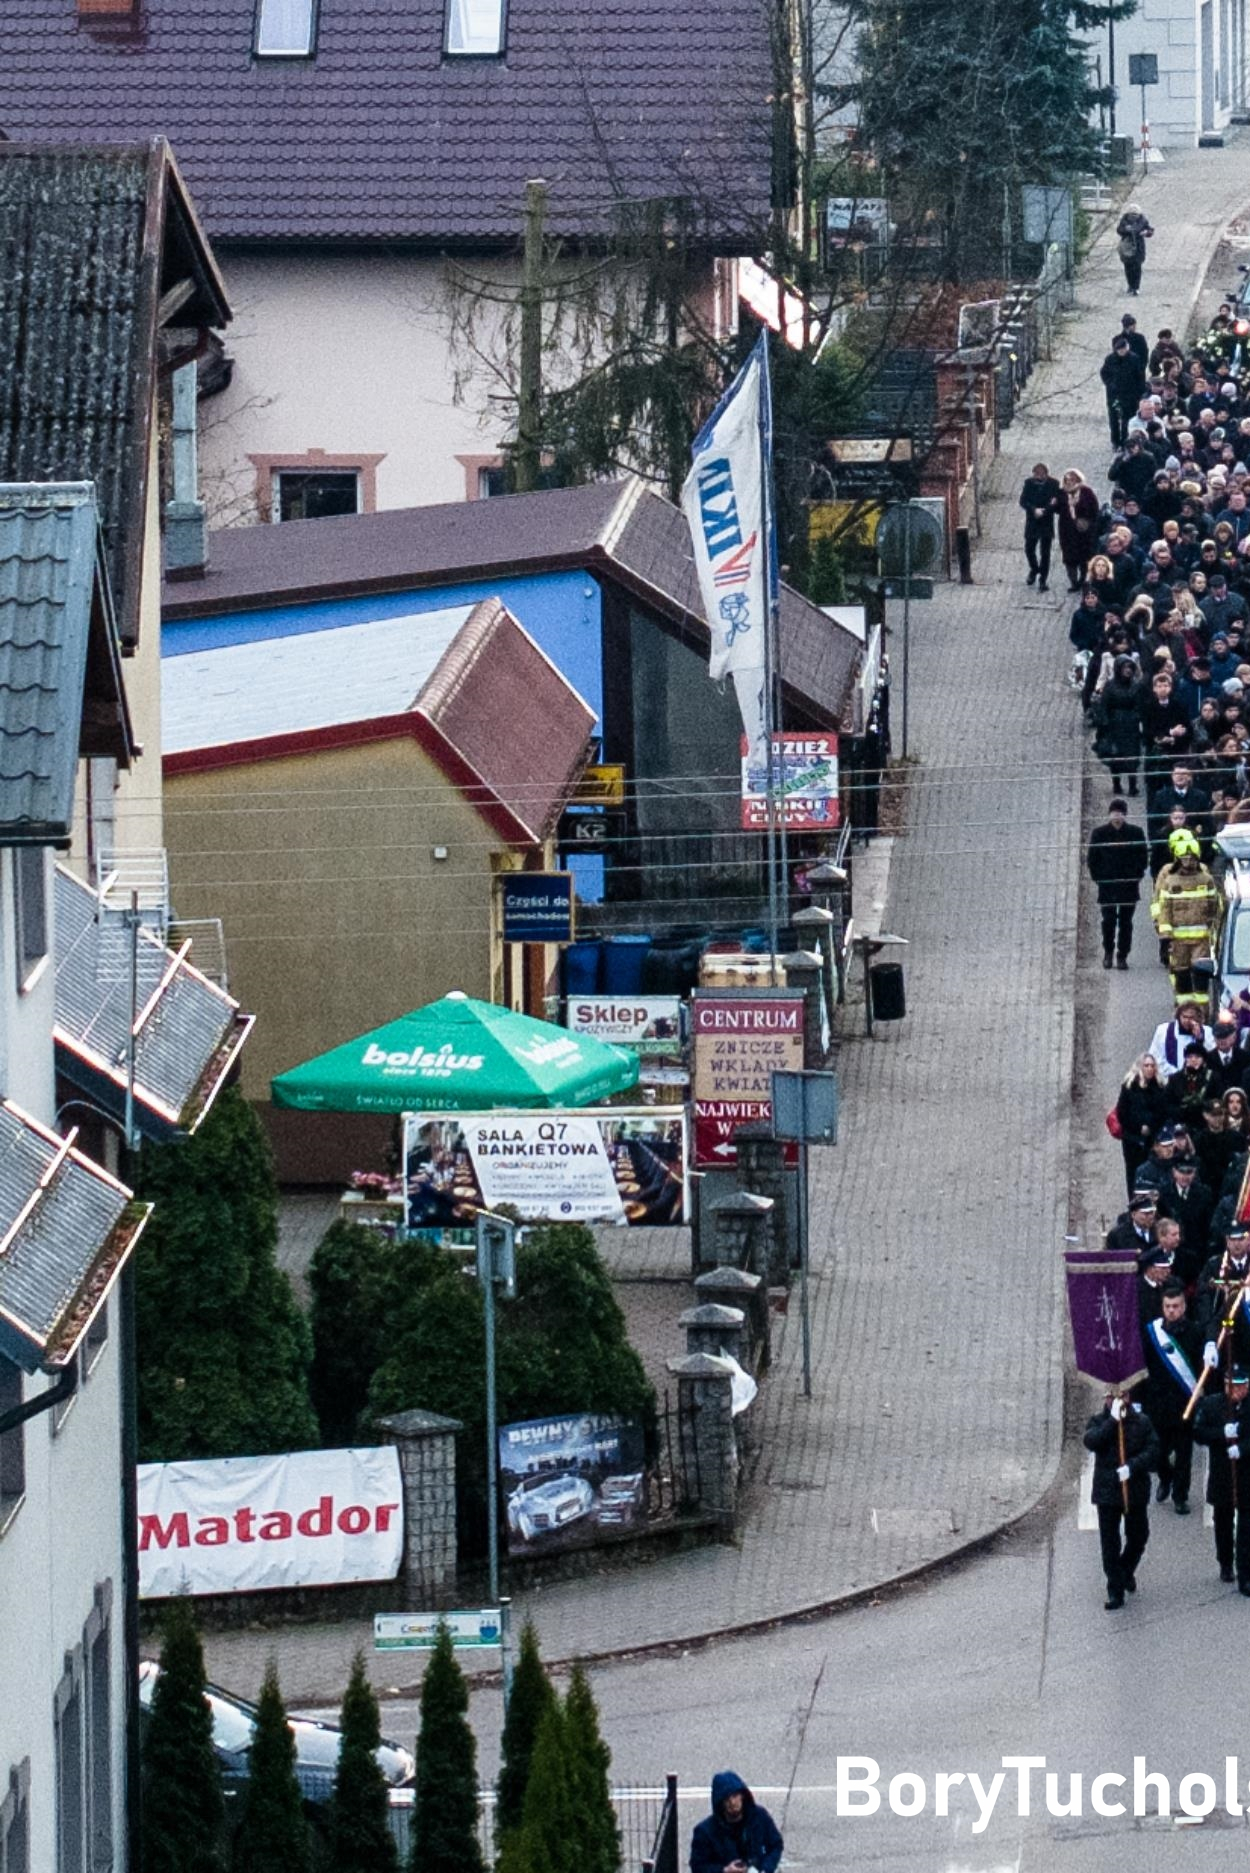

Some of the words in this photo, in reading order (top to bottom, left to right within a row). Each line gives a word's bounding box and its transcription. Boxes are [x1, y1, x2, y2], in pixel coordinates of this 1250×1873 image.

[575, 824, 606, 839] K2
[576, 1005, 648, 1026] Sklep
[700, 1009, 797, 1029] CENTRUM
[362, 1043, 485, 1070] bolsius
[714, 1041, 785, 1054] ZNICZE
[714, 1077, 771, 1091] KWIAT
[477, 1129, 523, 1141] SALA
[538, 1123, 568, 1140] Q7
[477, 1144, 599, 1155] BANKIETOWA
[138, 1496, 399, 1551] Matador
